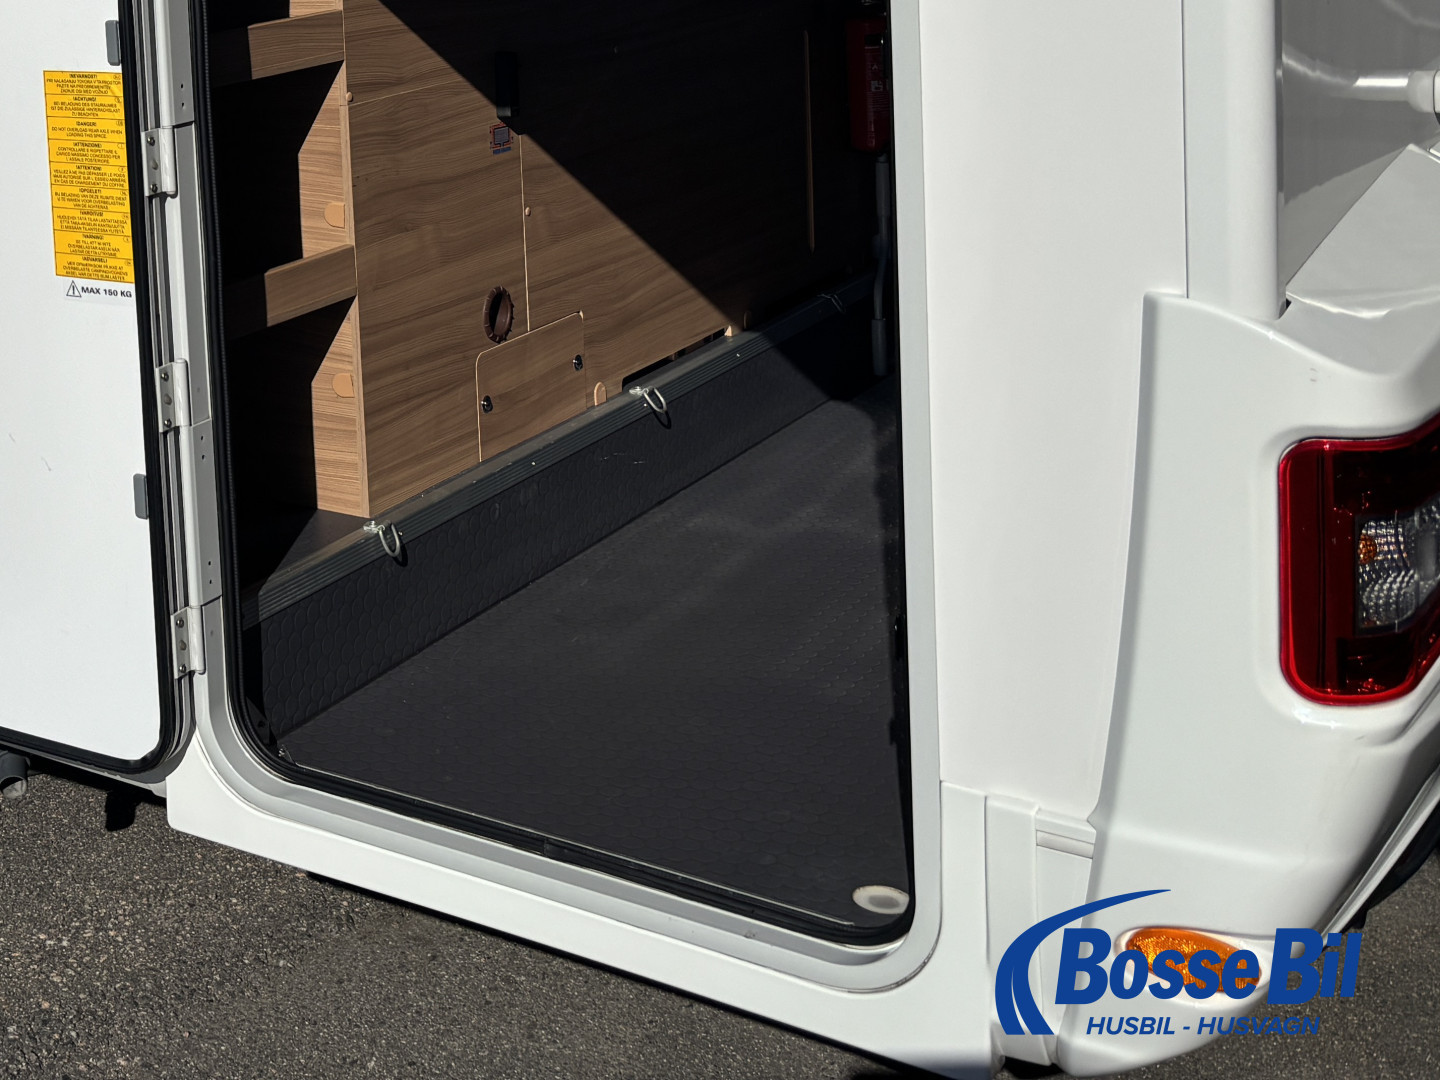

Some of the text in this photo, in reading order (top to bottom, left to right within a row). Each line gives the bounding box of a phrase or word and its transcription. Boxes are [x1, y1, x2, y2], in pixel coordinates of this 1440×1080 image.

[81, 286, 132, 298] MAX 150 KG
